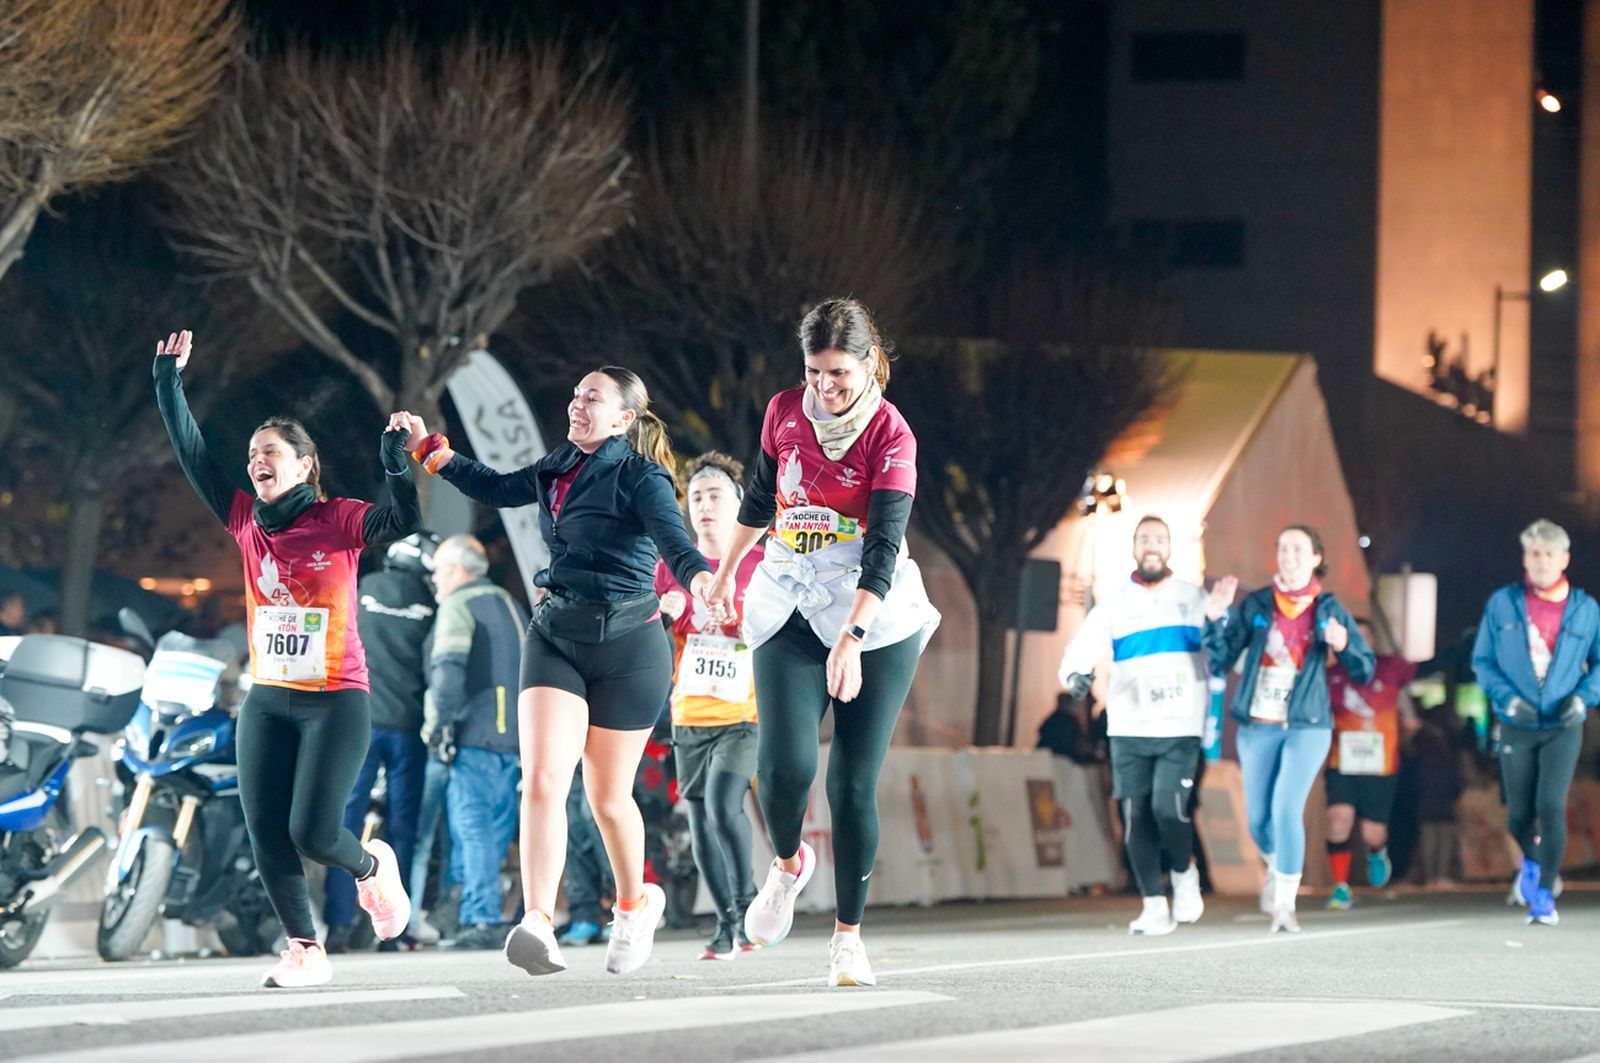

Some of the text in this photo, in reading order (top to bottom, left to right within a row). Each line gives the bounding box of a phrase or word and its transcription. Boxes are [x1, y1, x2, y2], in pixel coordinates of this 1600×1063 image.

[793, 512, 819, 521] NOCHE
[271, 588, 289, 607] 43
[287, 615, 297, 623] DE
[266, 633, 310, 656] 7607
[695, 657, 737, 679] 3155
[1264, 687, 1292, 702] 587
